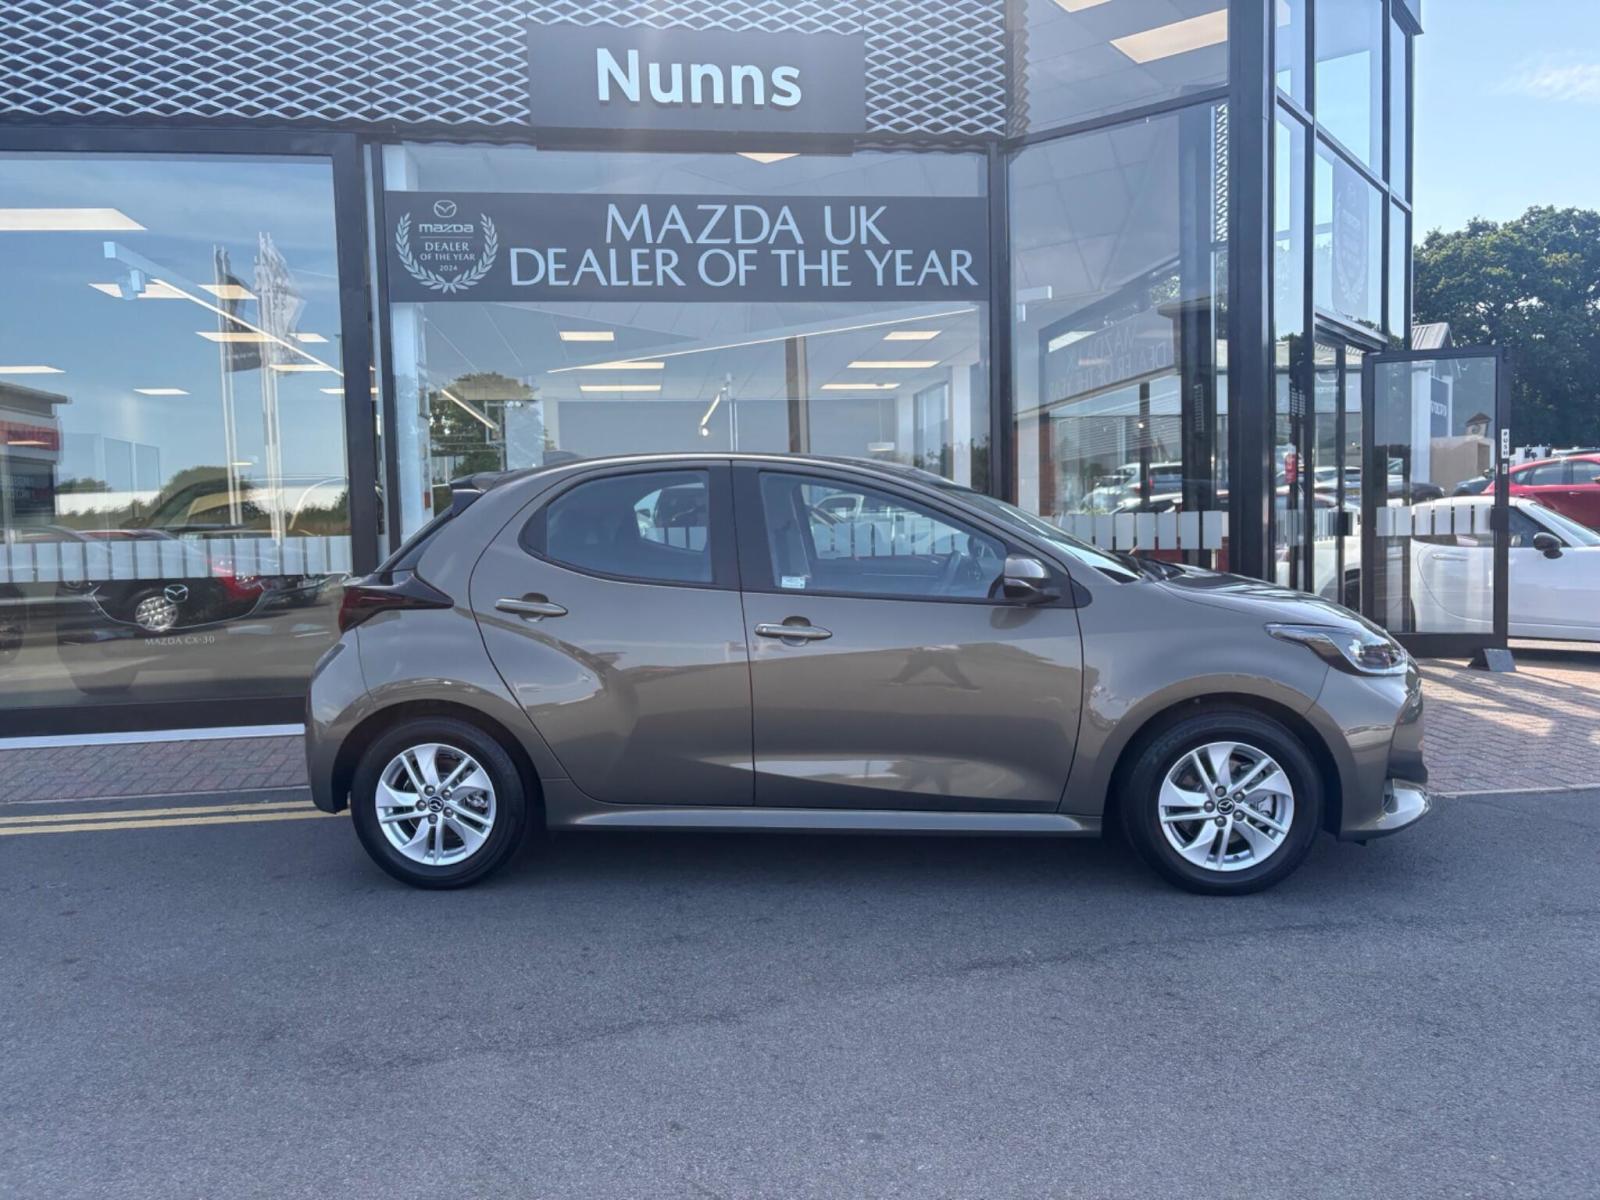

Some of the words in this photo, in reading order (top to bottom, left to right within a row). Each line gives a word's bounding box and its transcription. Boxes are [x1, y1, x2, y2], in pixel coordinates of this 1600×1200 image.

[596, 47, 803, 107] Nunns
[418, 223, 475, 233] mazda
[605, 203, 805, 245] MAZDA
[824, 205, 891, 245] UK
[424, 242, 470, 252] DEALER
[420, 253, 432, 261] OF
[435, 253, 451, 261] THE
[453, 253, 476, 261] YEAR
[439, 264, 458, 272] 2024
[509, 247, 687, 287] DEALER
[697, 248, 758, 287] OF
[770, 249, 852, 287] THE
[864, 249, 979, 287] YEAR
